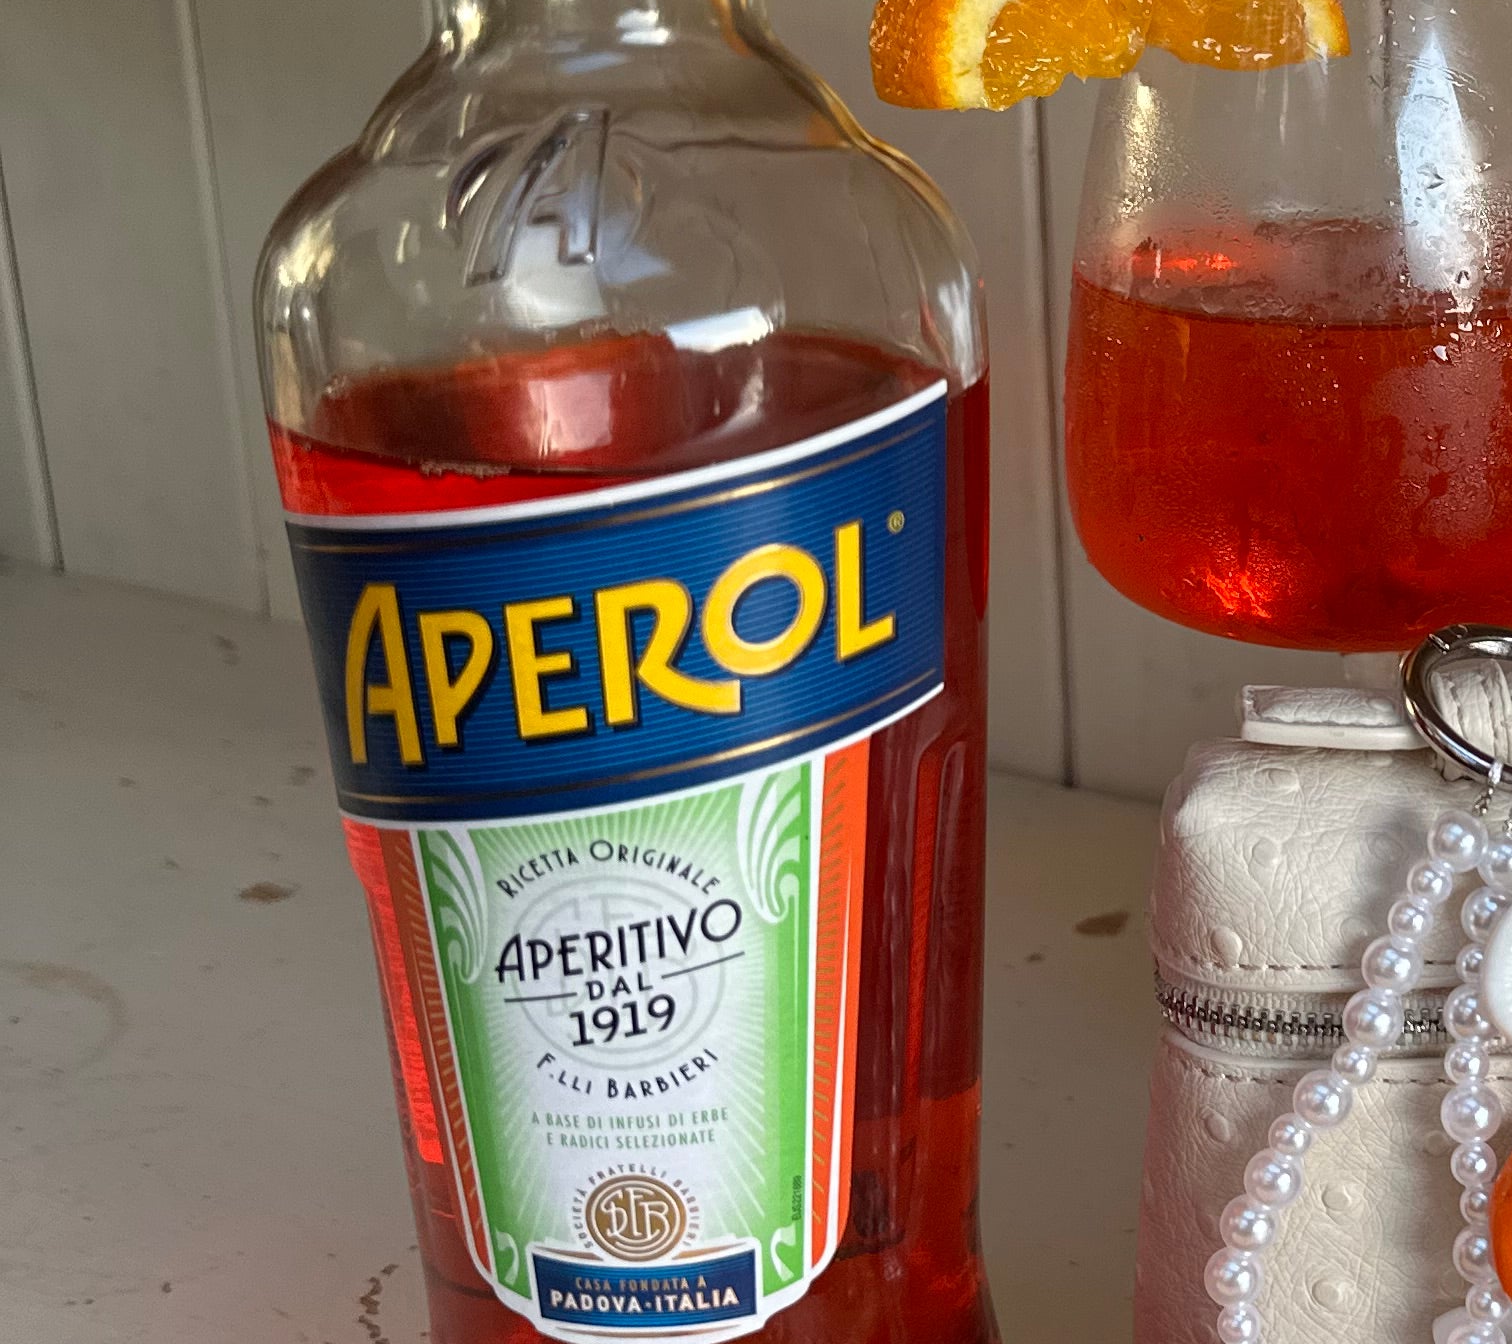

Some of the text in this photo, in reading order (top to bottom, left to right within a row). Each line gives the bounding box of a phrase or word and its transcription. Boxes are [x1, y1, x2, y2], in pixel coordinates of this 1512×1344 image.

[345, 521, 898, 768] APEROL
[496, 839, 720, 899] RICETTA ORIGINALE
[494, 898, 743, 984] APERITIVO
[585, 972, 653, 1001] DAL
[569, 993, 676, 1047] 1919
[607, 1048, 718, 1100] BARBIERI
[531, 1107, 729, 1129] A BASE DI INFUSI DI ERBE
[560, 1133, 609, 1149] RADICI
[616, 1128, 715, 1149] SELEZIONATE
